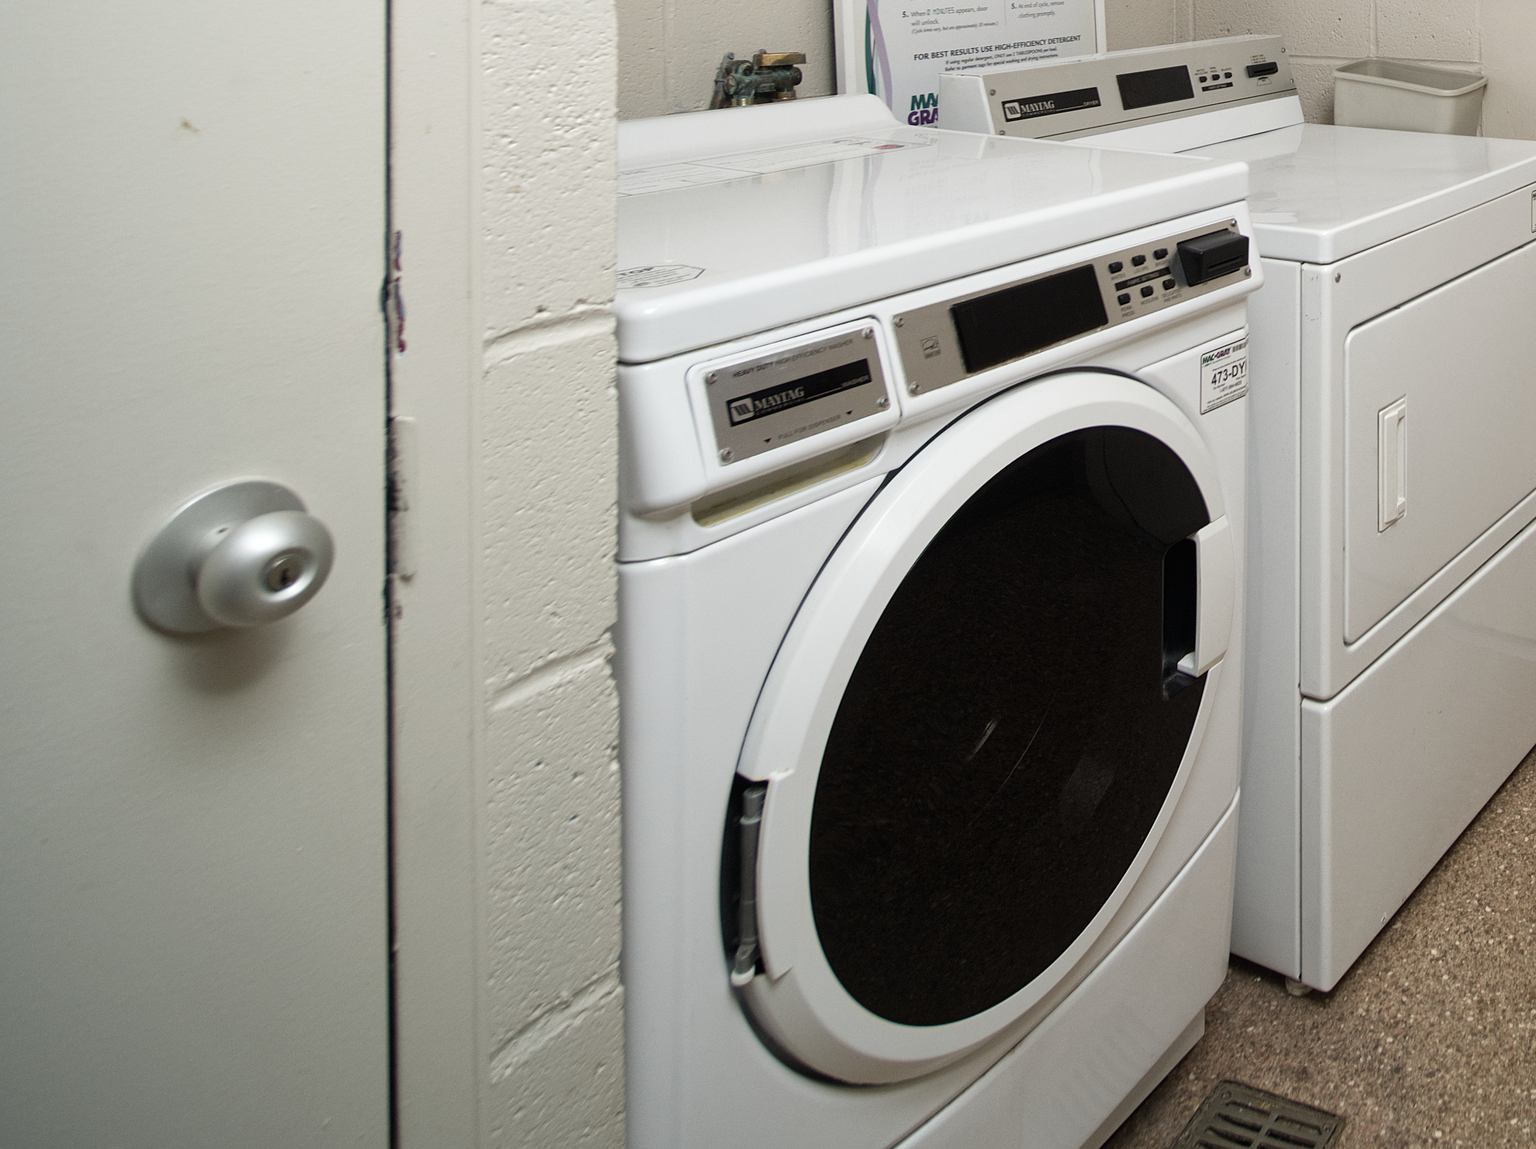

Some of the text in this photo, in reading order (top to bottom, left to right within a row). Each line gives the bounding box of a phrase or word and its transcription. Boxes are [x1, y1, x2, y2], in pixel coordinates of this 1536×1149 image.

[950, 47, 979, 56] RESULTS
[995, 39, 1046, 51] HIGH-EFFICIENCY
[1048, 35, 1081, 44] DETERGENT
[911, 93, 938, 111] MA
[1021, 100, 1054, 113] MAYTAG
[753, 386, 805, 411] MAYTAG
